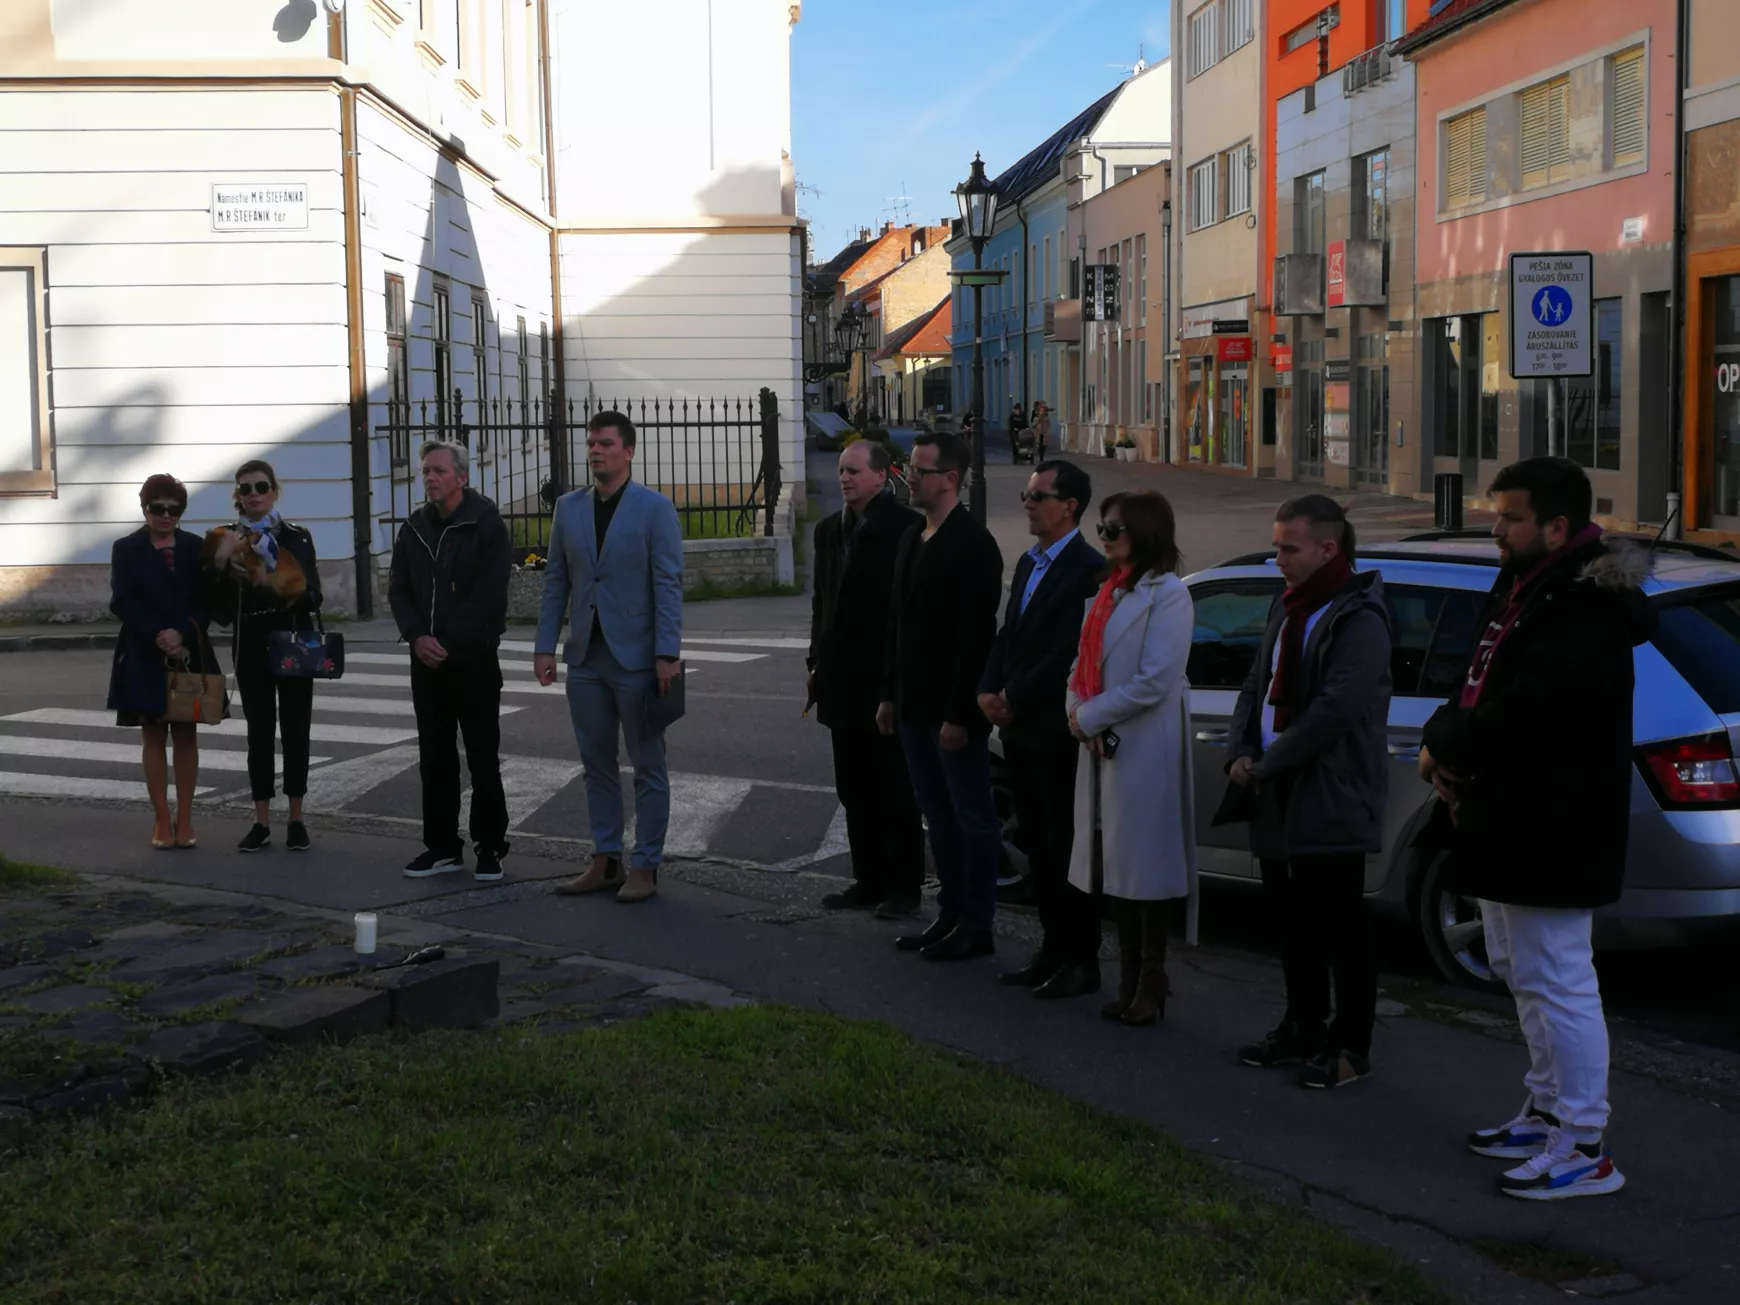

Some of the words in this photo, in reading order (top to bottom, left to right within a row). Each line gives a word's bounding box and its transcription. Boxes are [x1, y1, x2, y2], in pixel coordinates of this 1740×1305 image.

[1529, 260, 1551, 271] PEŠIA
[1554, 261, 1573, 271] ZÓNA
[1518, 273, 1555, 283] GYALOGOS
[1527, 330, 1576, 339] ZÁSOBOVANIE
